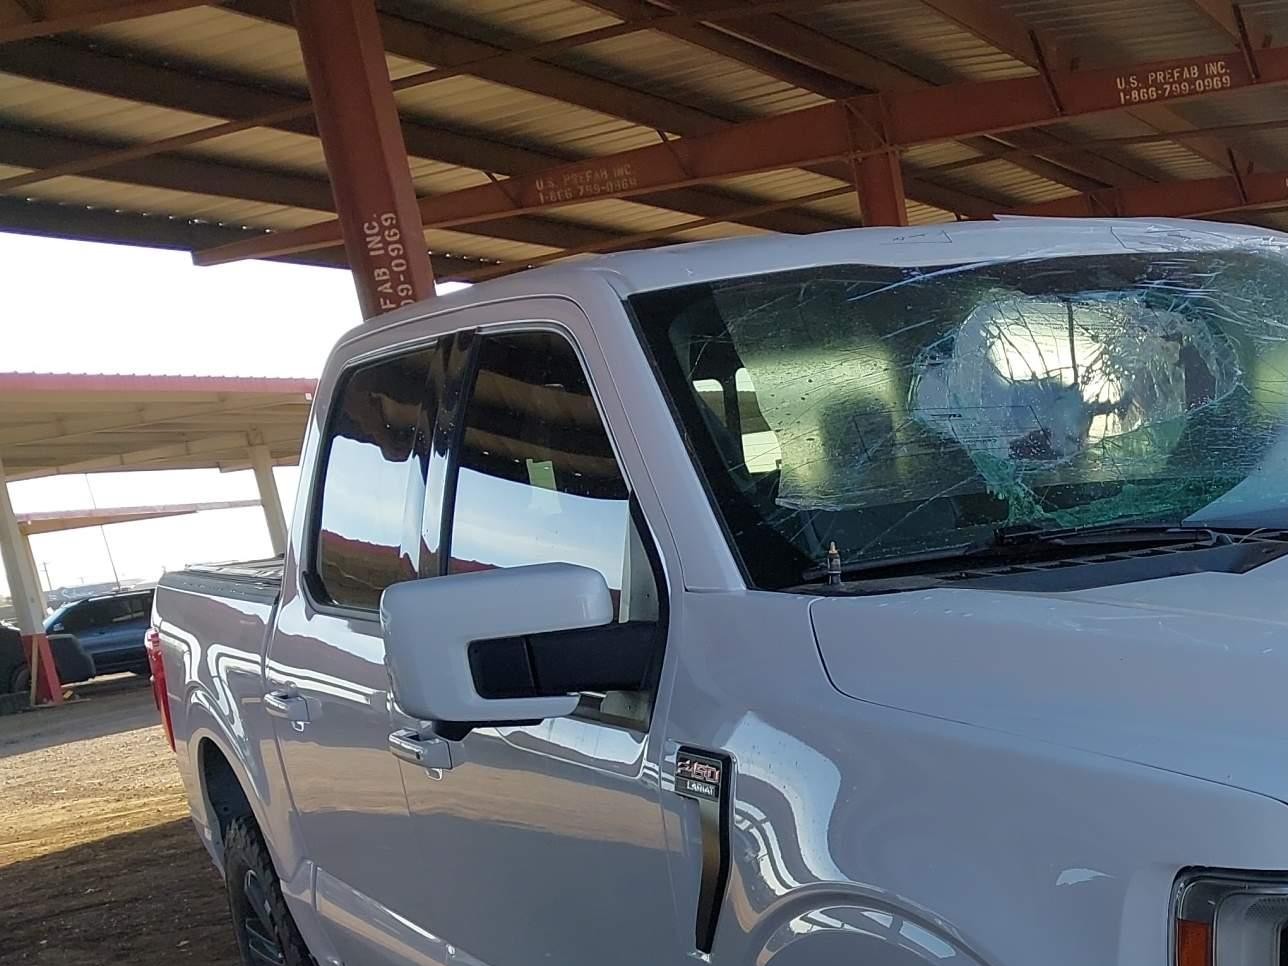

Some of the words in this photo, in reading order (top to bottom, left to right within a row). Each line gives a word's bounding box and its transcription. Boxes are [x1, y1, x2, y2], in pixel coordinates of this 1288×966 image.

[1116, 75, 1142, 90] U.S.
[1148, 65, 1199, 84] PREFAB
[1204, 61, 1230, 75] INC.
[1119, 75, 1231, 104] 1-866-799-0969
[363, 213, 385, 256] INC.
